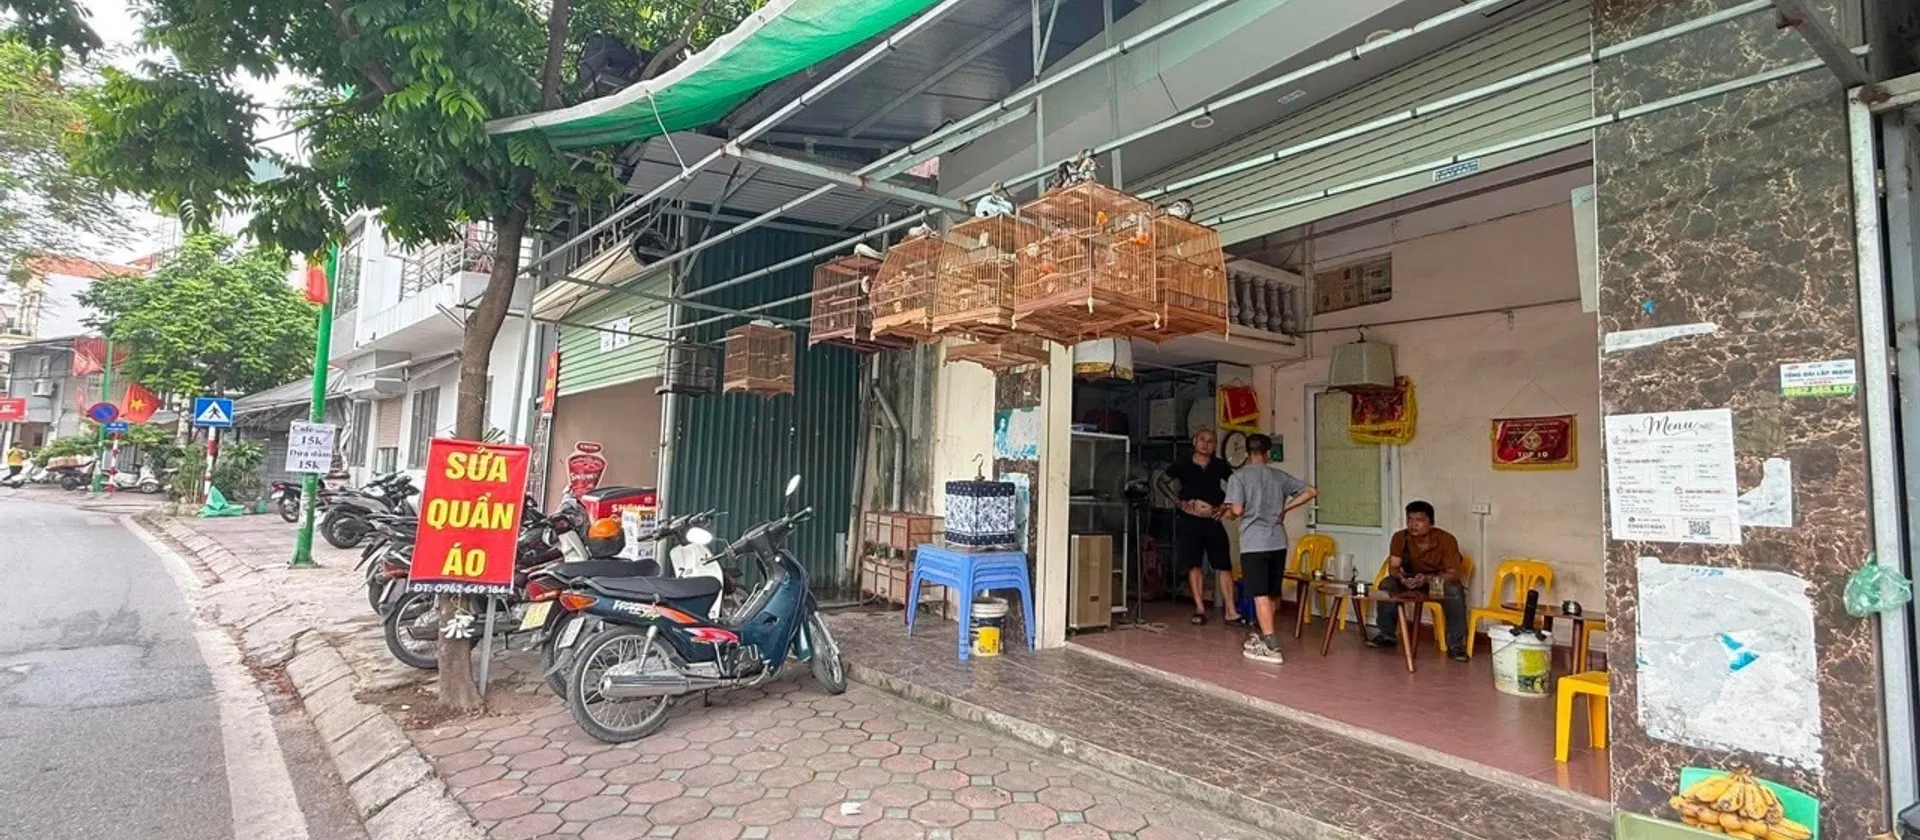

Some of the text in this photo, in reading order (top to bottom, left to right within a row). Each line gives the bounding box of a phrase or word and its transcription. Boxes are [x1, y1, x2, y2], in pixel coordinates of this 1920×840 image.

[1643, 415, 1699, 436] Menu
[301, 435, 322, 445] 15k
[299, 460, 320, 470] 15k
[426, 492, 515, 530] QUẦN
[441, 542, 487, 577] ÁO
